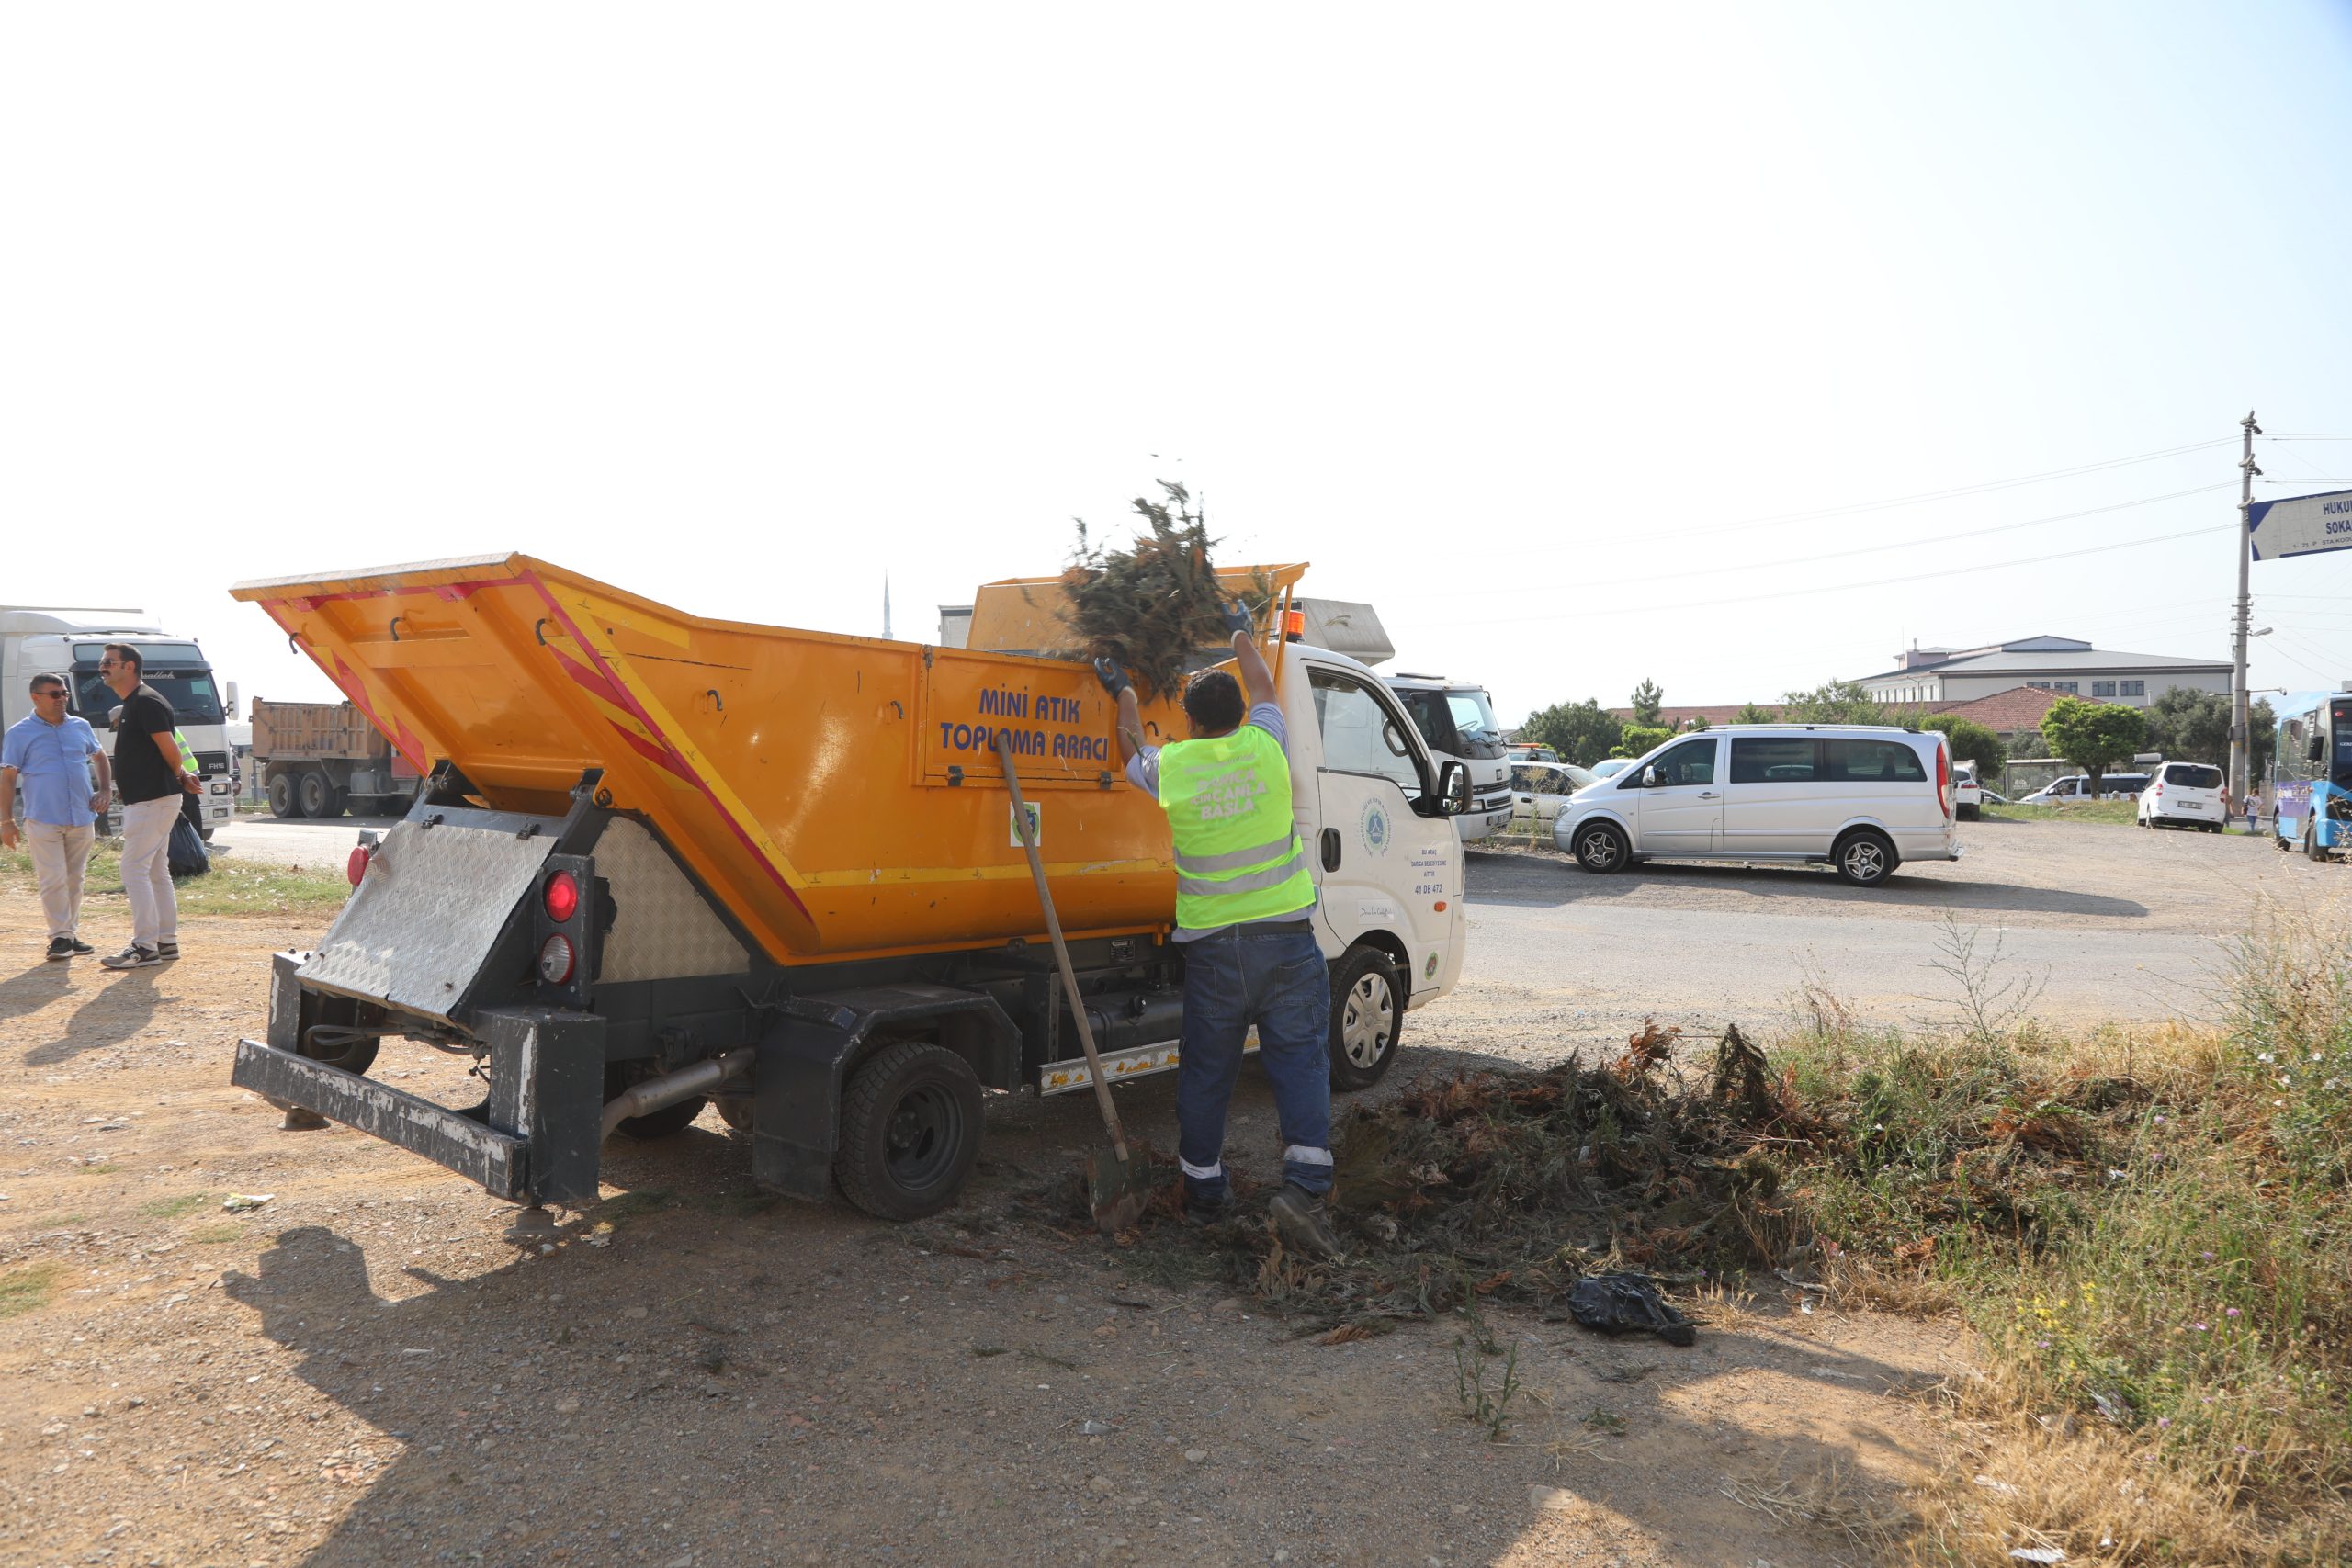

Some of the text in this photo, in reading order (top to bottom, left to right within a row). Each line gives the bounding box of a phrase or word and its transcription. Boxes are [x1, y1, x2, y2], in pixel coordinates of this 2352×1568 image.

[2323, 501, 2352, 515] HUKU
[2325, 519, 2352, 534] SOKA
[978, 682, 1080, 724] MİNİ ATIK
[940, 722, 1108, 761] TOPLAMA ARACI
[1202, 799, 1255, 819] BAŞLA
[1415, 884, 1442, 895] 41 DB 472
